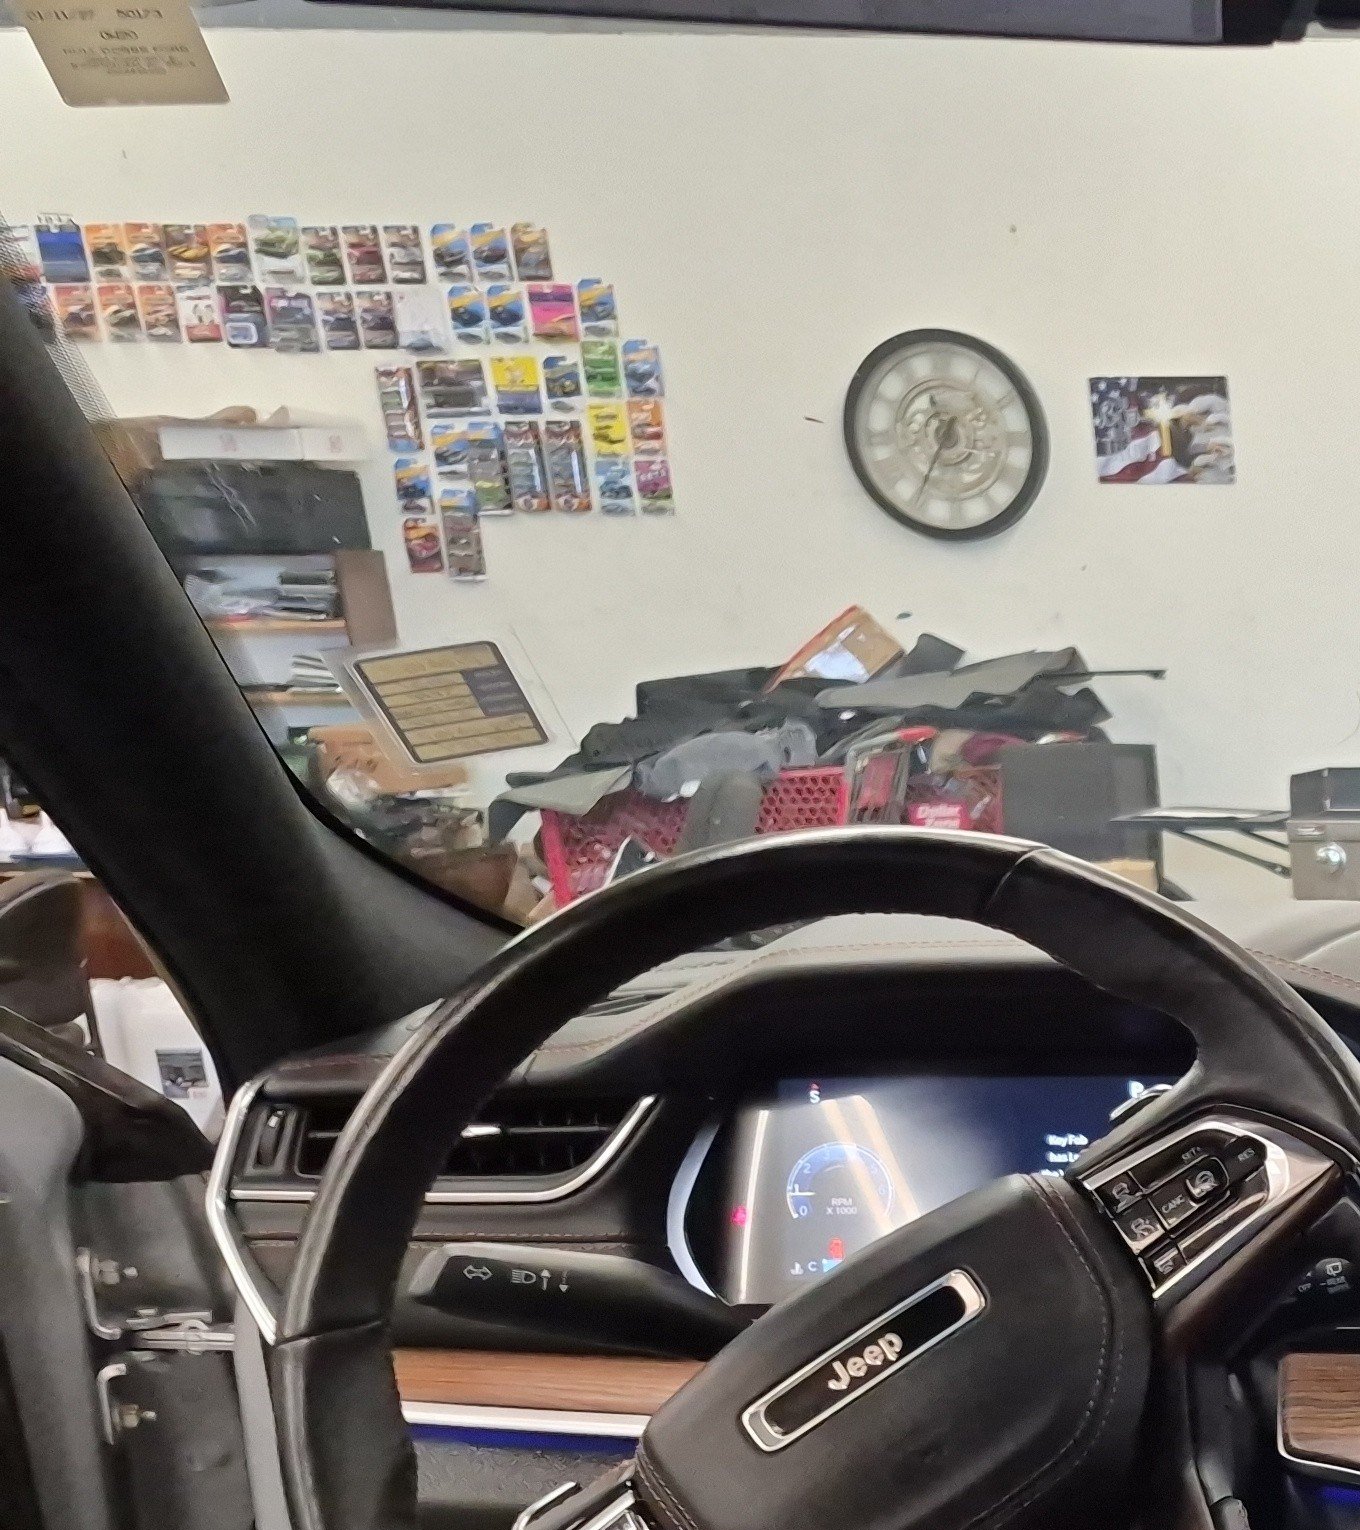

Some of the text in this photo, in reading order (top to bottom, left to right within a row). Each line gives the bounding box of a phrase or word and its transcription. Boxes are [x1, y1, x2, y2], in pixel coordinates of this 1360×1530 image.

[831, 1197, 853, 1206] RPM
[836, 1206, 858, 1215] 1000
[827, 1332, 904, 1391] Jeep
